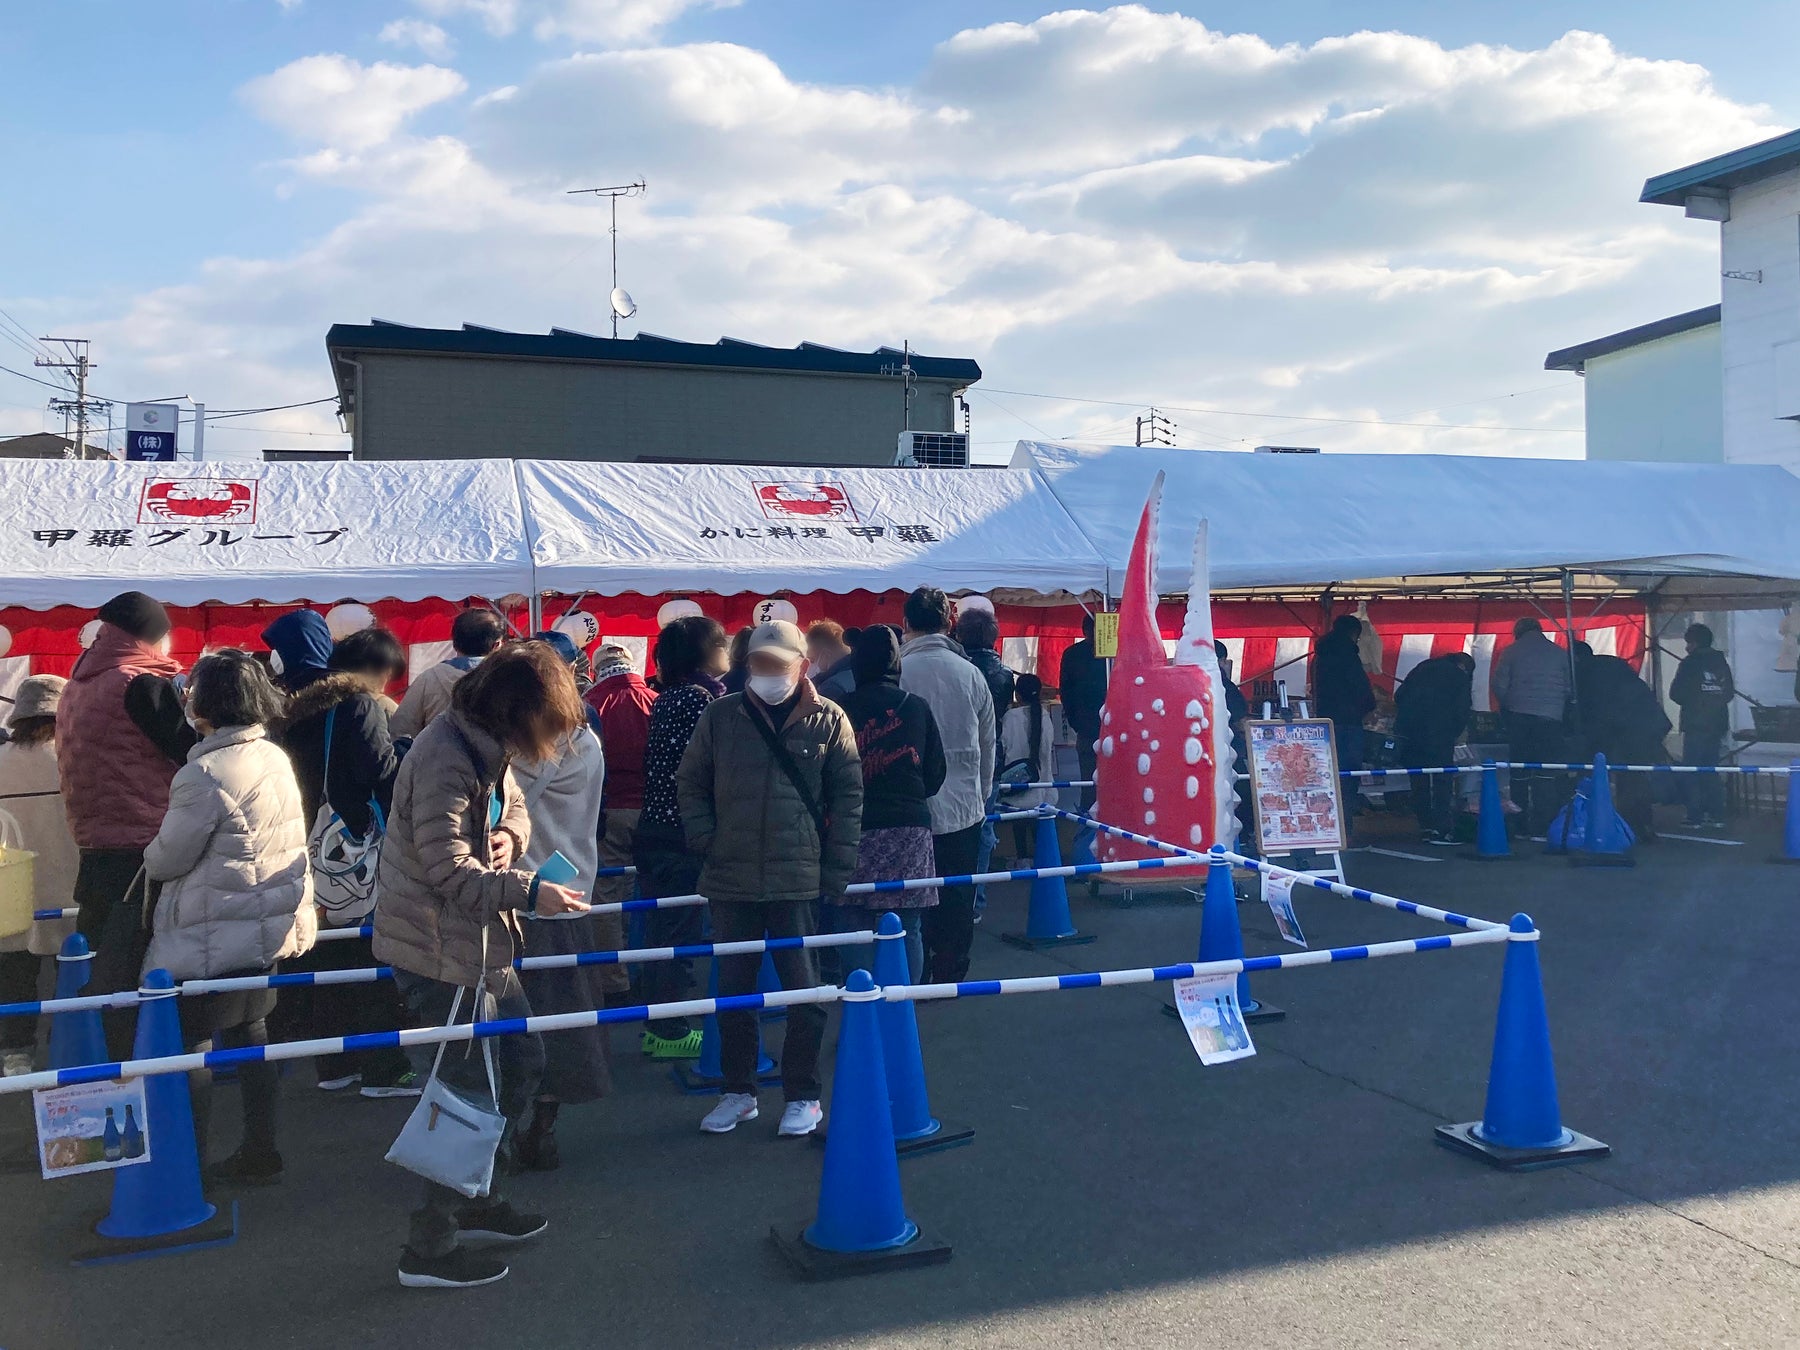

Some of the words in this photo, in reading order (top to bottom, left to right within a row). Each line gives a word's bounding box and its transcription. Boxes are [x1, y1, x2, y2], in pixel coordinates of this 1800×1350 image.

[137, 435, 162, 449] (株)
[33, 527, 350, 548] 甲羅グループ
[699, 526, 831, 541] かに料理
[847, 525, 941, 543] 甲羅
[759, 602, 775, 623] ずわ
